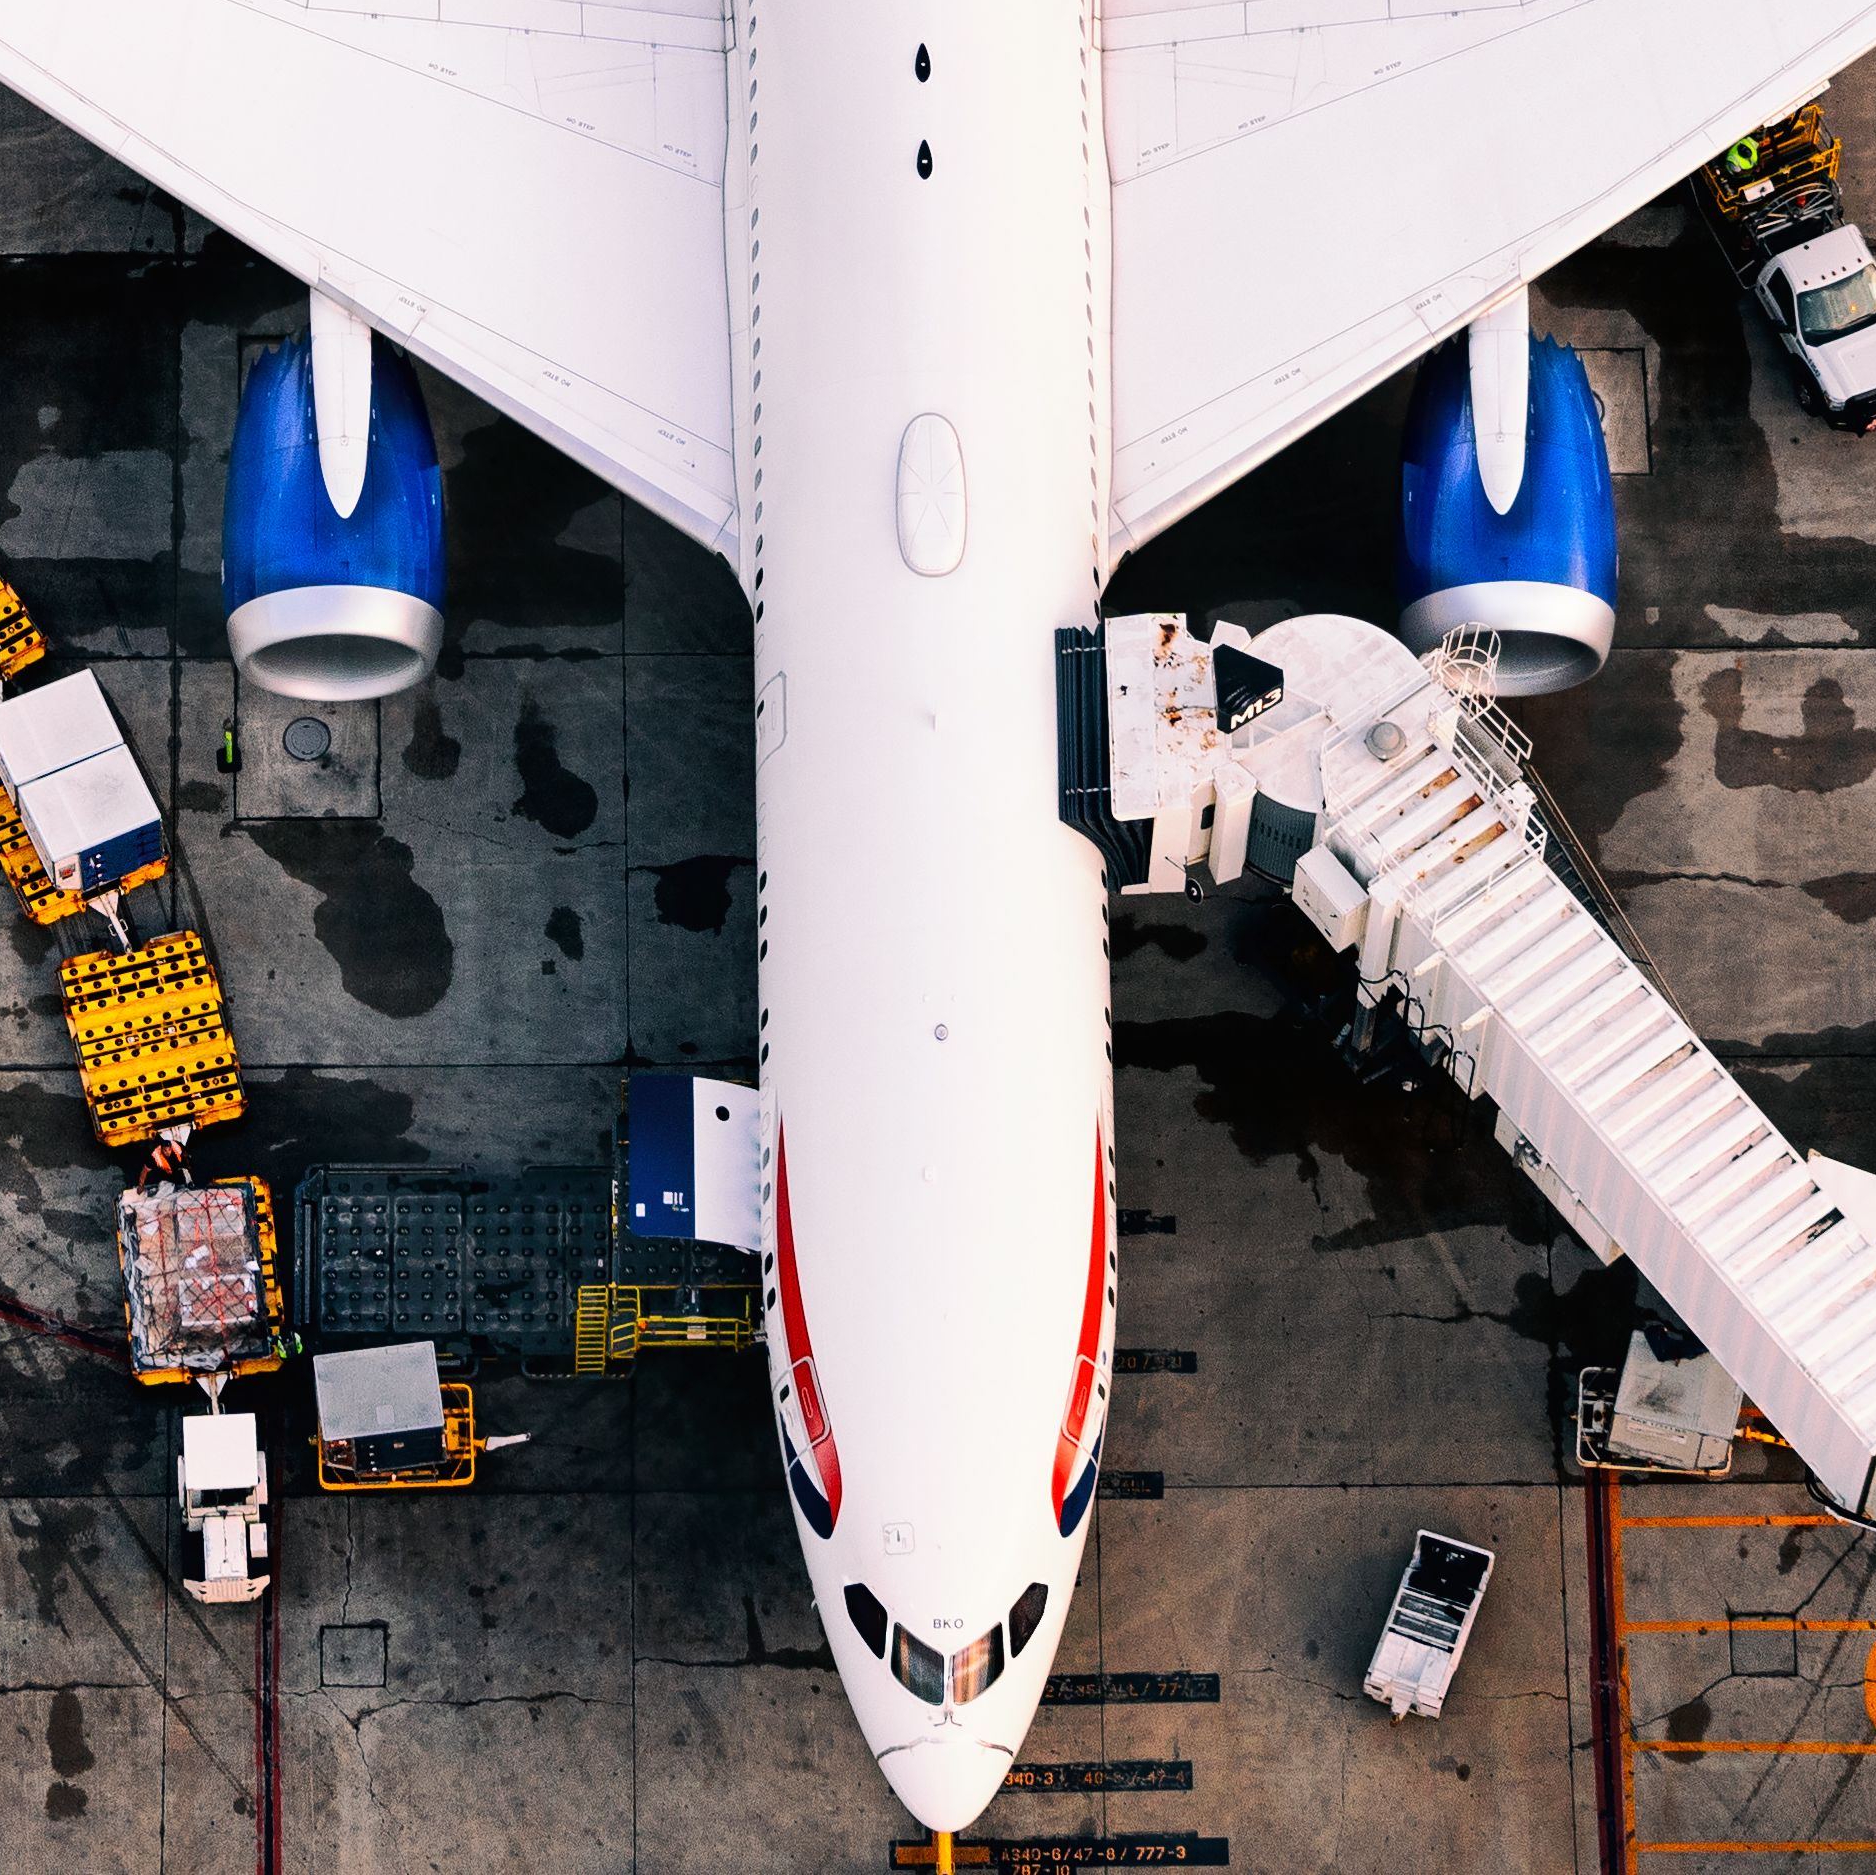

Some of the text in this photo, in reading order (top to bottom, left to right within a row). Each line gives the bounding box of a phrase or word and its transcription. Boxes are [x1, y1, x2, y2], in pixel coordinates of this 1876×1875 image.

[440, 67, 457, 76] STEP
[1385, 60, 1402, 71] STEP
[578, 121, 595, 131] STEP
[1238, 115, 1266, 130] NO STEP
[675, 148, 692, 157] STEP
[1141, 143, 1170, 157] NO STEP
[399, 296, 427, 314] NO STEP
[1415, 292, 1442, 310] NO STEP
[543, 371, 572, 388] NO STEP
[1274, 367, 1301, 385] NO STEP
[657, 429, 686, 446] NO STEP
[1160, 426, 1188, 444] NO STEP
[1230, 687, 1282, 730] M13
[933, 1618, 964, 1629] BKO
[1135, 1845, 1186, 1861] 777-3
